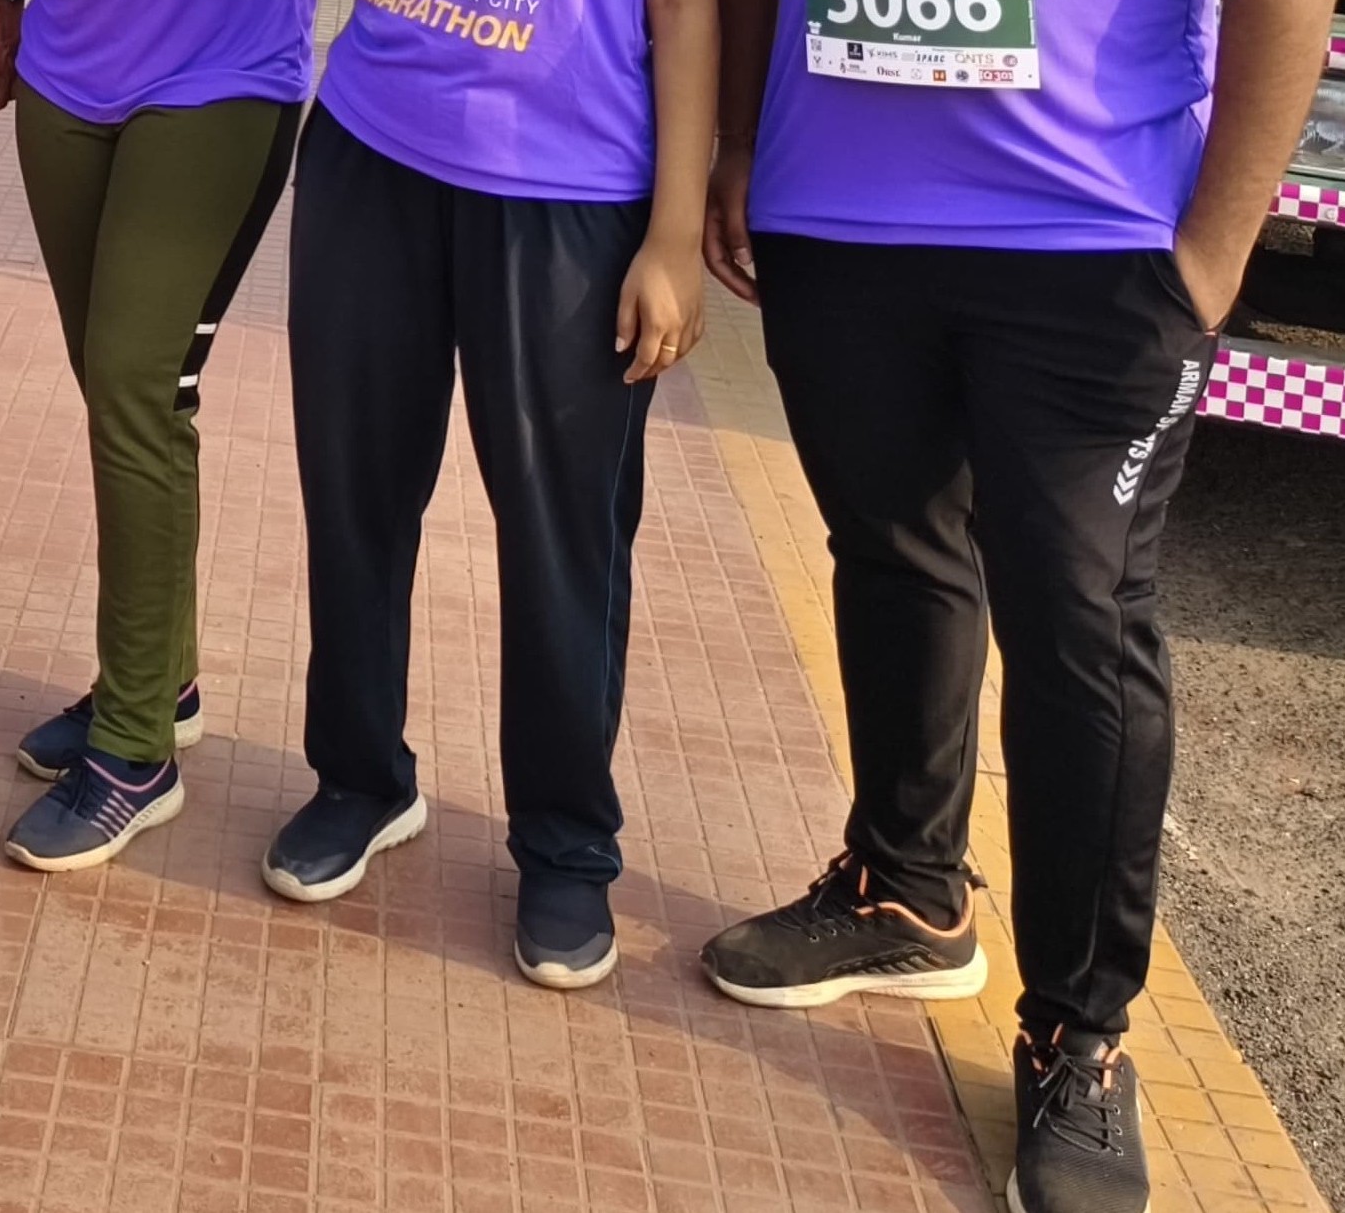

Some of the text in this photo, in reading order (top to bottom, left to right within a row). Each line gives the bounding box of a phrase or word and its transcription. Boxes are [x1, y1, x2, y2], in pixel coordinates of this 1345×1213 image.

[892, 32, 922, 43] Kumar
[1128, 359, 1200, 459] ARMAN SPTS
